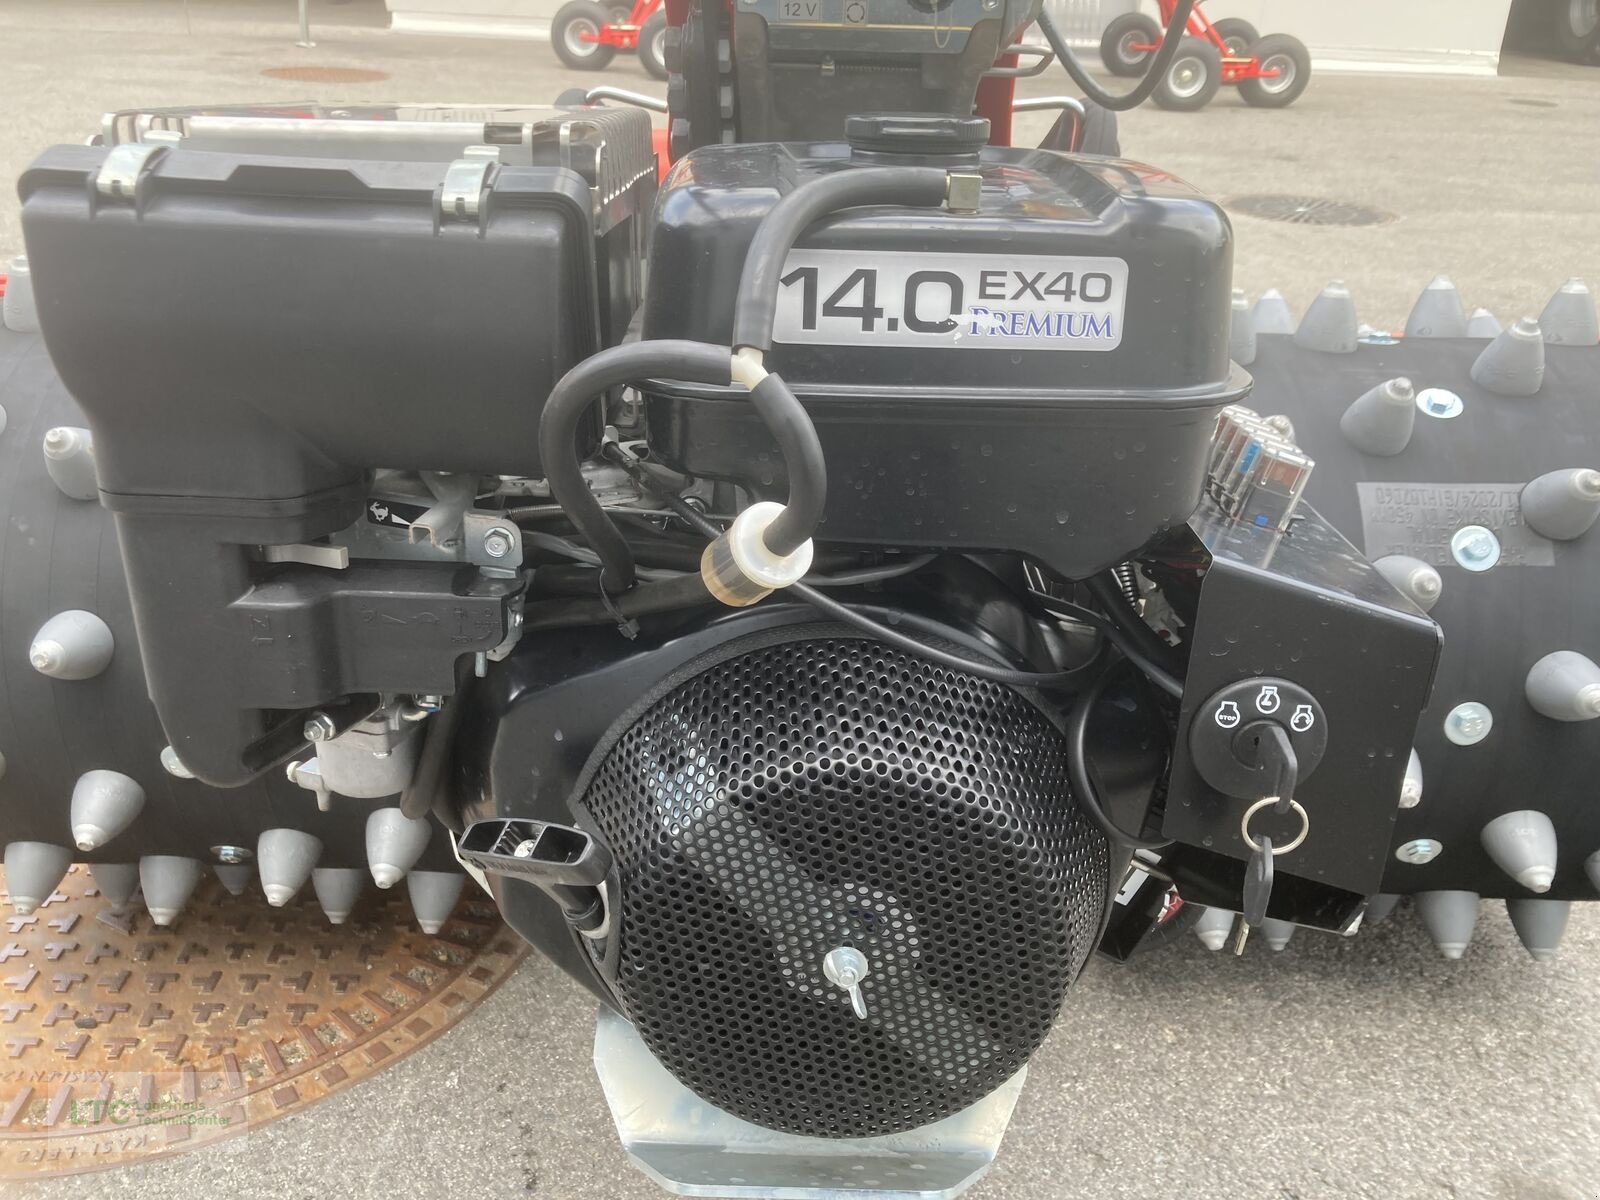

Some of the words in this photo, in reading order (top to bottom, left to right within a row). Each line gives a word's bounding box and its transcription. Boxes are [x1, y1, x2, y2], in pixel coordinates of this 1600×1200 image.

[784, 2, 801, 17] 12
[806, 2, 817, 17] V
[780, 266, 964, 334] 14.0
[979, 270, 1112, 302] EX40
[969, 305, 1115, 339] PREMIUM
[1219, 714, 1237, 722] STOP
